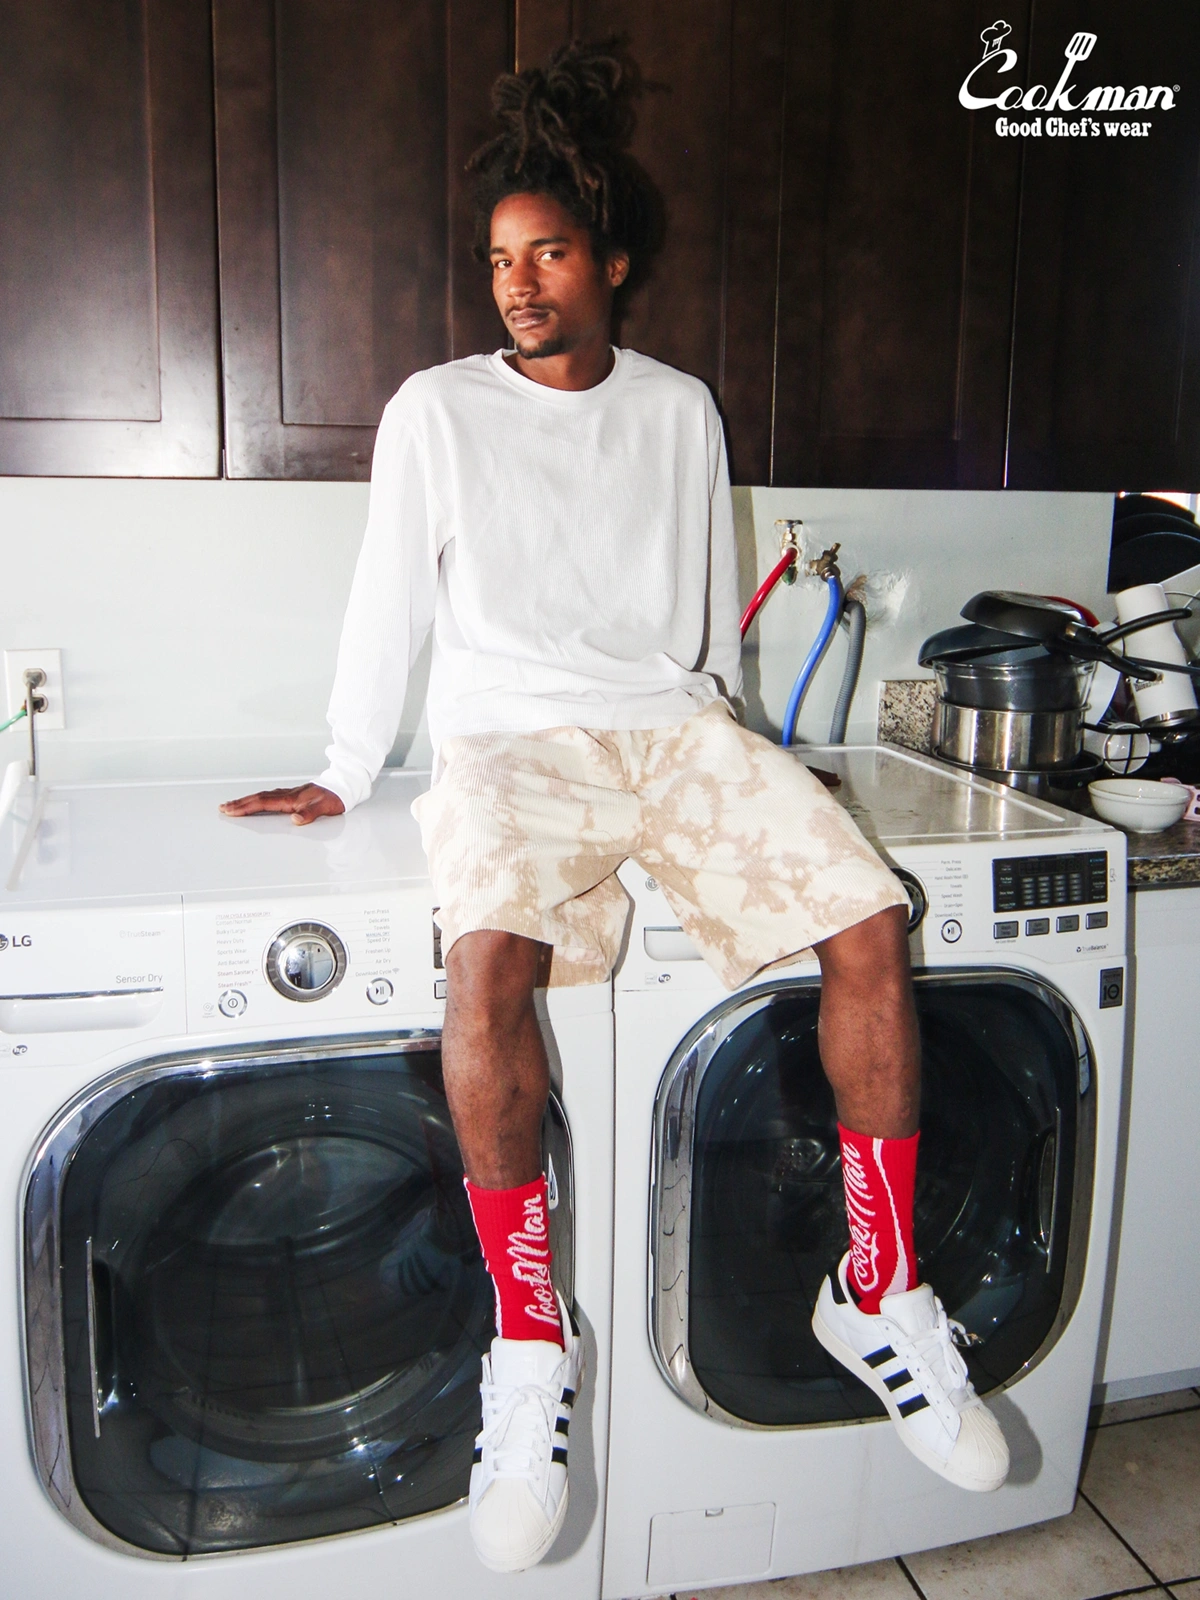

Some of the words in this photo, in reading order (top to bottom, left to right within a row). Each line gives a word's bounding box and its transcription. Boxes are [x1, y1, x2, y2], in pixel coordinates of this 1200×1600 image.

[12, 935, 32, 947] LG
[115, 975, 146, 984] Sensor
[147, 973, 163, 983] Dry
